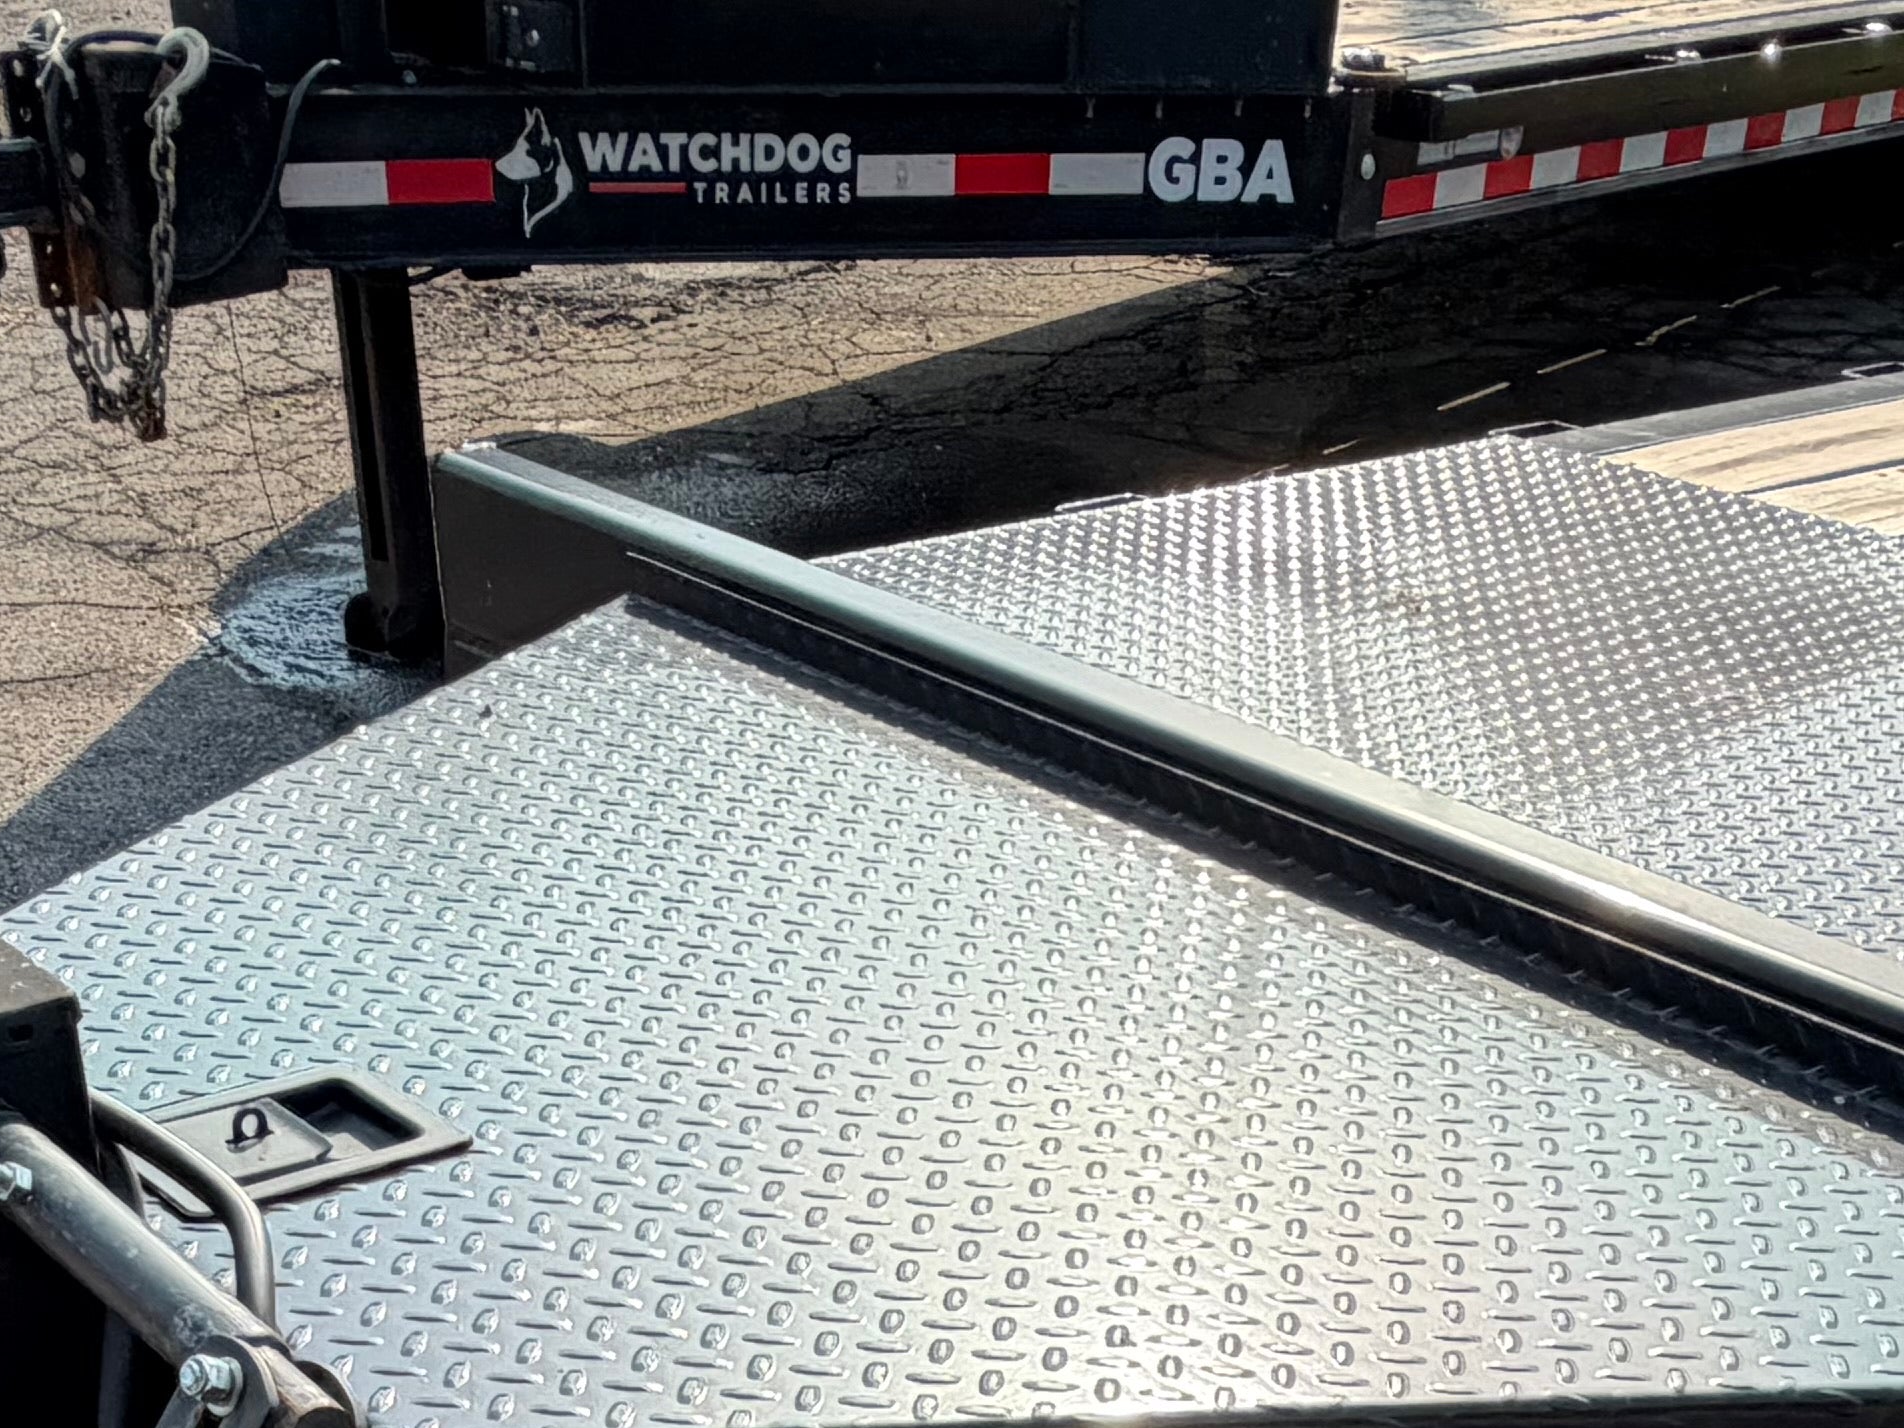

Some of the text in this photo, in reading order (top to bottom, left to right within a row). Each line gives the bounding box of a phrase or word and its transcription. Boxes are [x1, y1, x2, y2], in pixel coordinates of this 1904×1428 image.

[578, 131, 852, 174] WATCHDOG
[1148, 136, 1295, 204] GBA
[693, 181, 852, 205] TRAILERS
